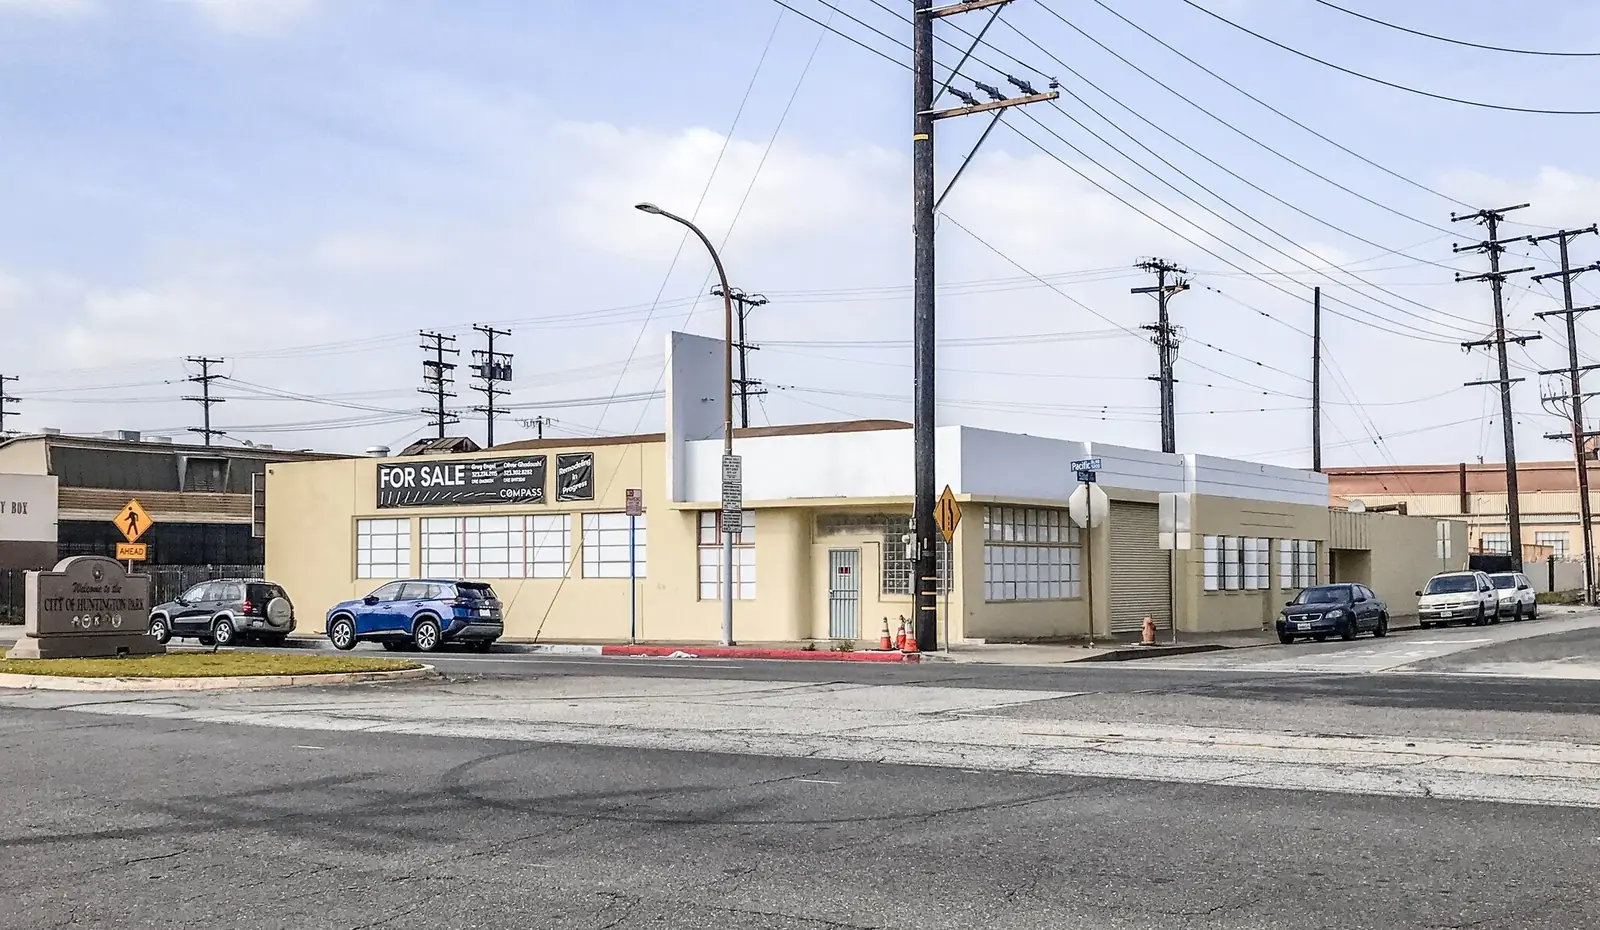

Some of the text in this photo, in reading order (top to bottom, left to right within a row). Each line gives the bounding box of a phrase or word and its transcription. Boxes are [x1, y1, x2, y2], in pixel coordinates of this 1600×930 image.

[559, 459, 590, 475] Remodeling
[1072, 461, 1091, 470] Pacific
[381, 465, 465, 488] FOR SALE
[500, 488, 542, 498] COMPASS
[562, 481, 587, 494] Progress
[11, 501, 28, 514] BOX
[119, 547, 144, 556] AHEAD
[72, 582, 122, 593] Welcome to the
[44, 597, 145, 612] CITY OF HUNTINGTON PARK
